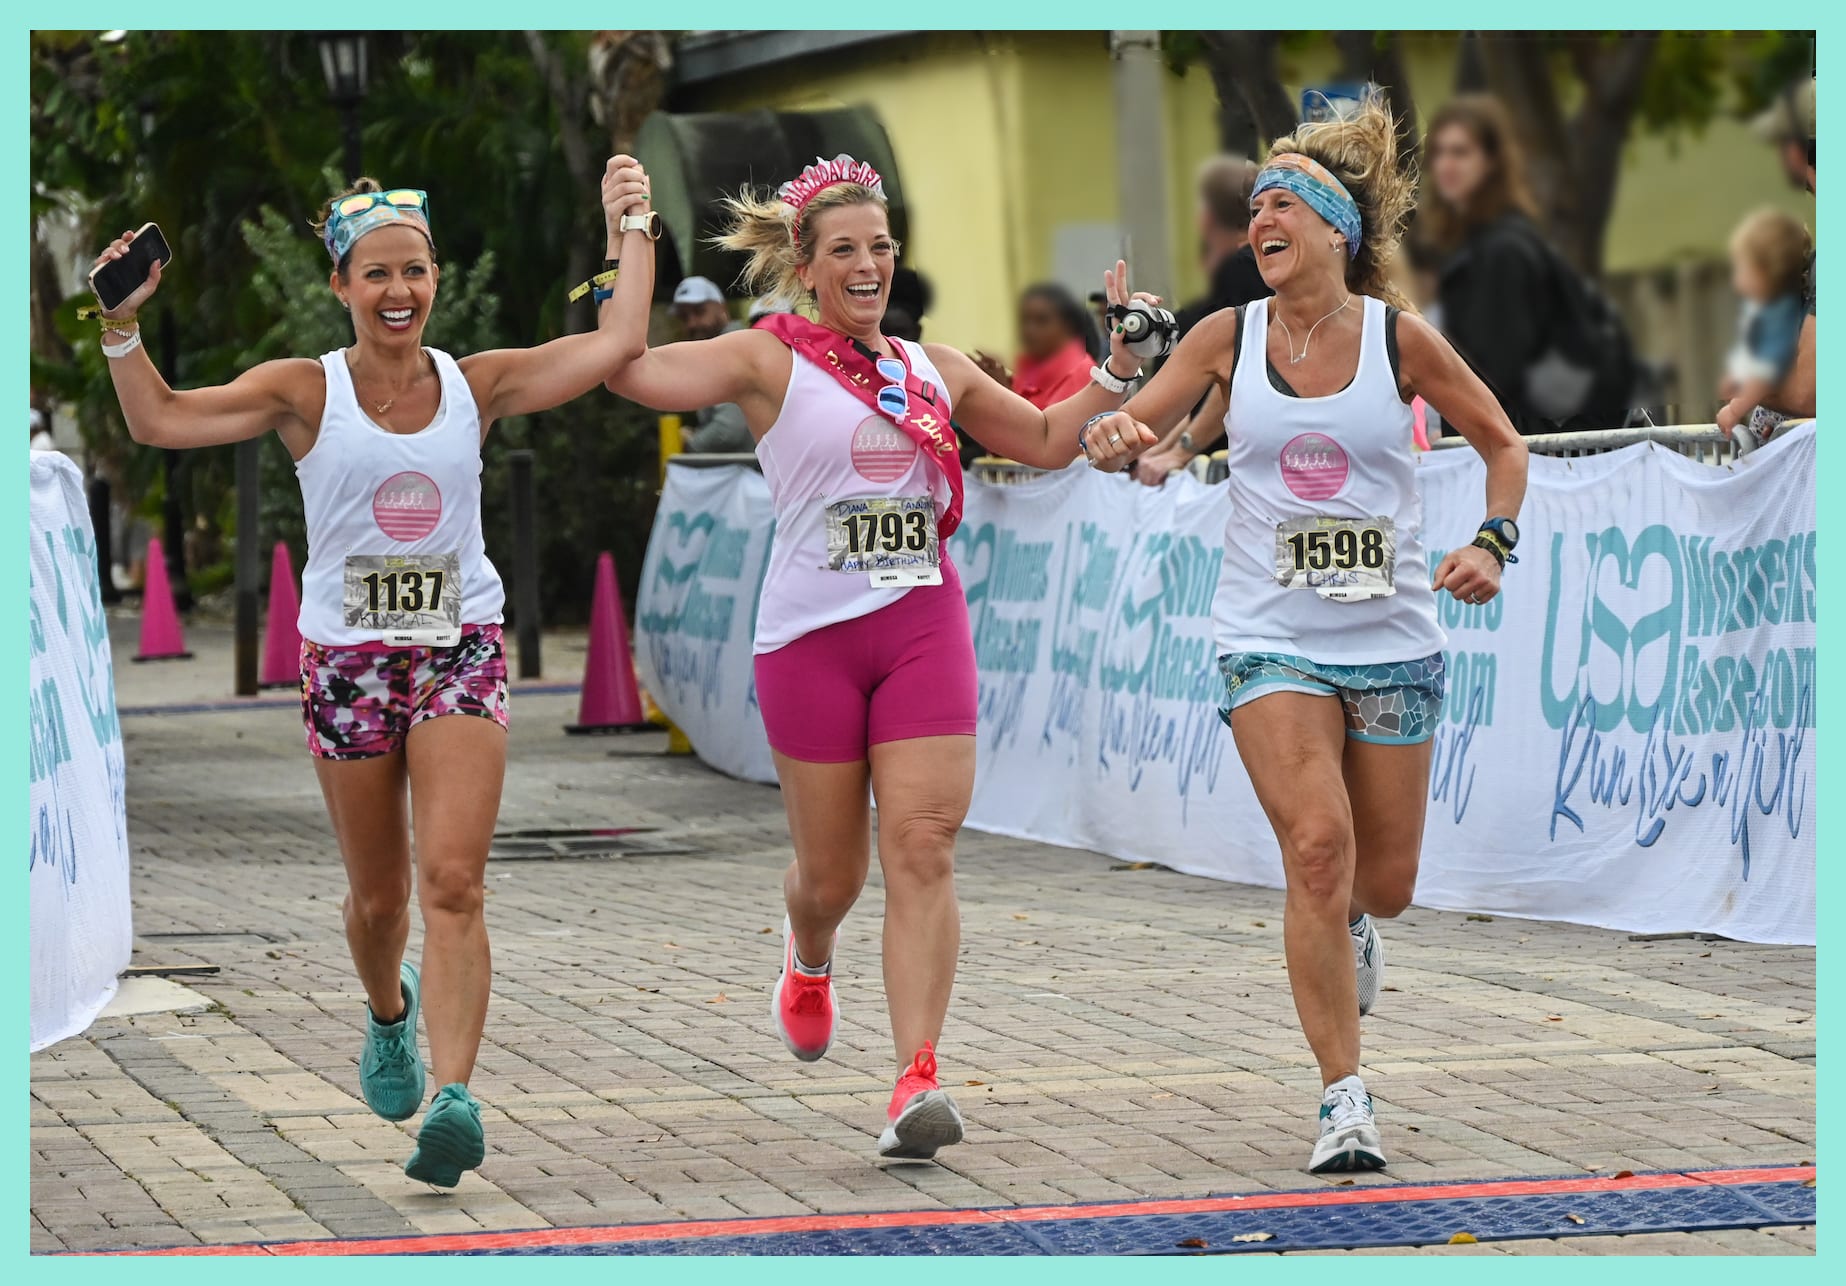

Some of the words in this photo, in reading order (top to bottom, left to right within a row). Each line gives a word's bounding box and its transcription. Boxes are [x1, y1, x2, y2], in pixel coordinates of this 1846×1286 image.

[783, 159, 846, 209] BIRTHDAY
[848, 161, 884, 188] GIRL
[841, 511, 927, 553] 1793
[1287, 529, 1384, 570] 1598
[875, 552, 925, 568] BIRTHDAY
[1306, 571, 1360, 587] CHRIS
[362, 571, 444, 612] 1137
